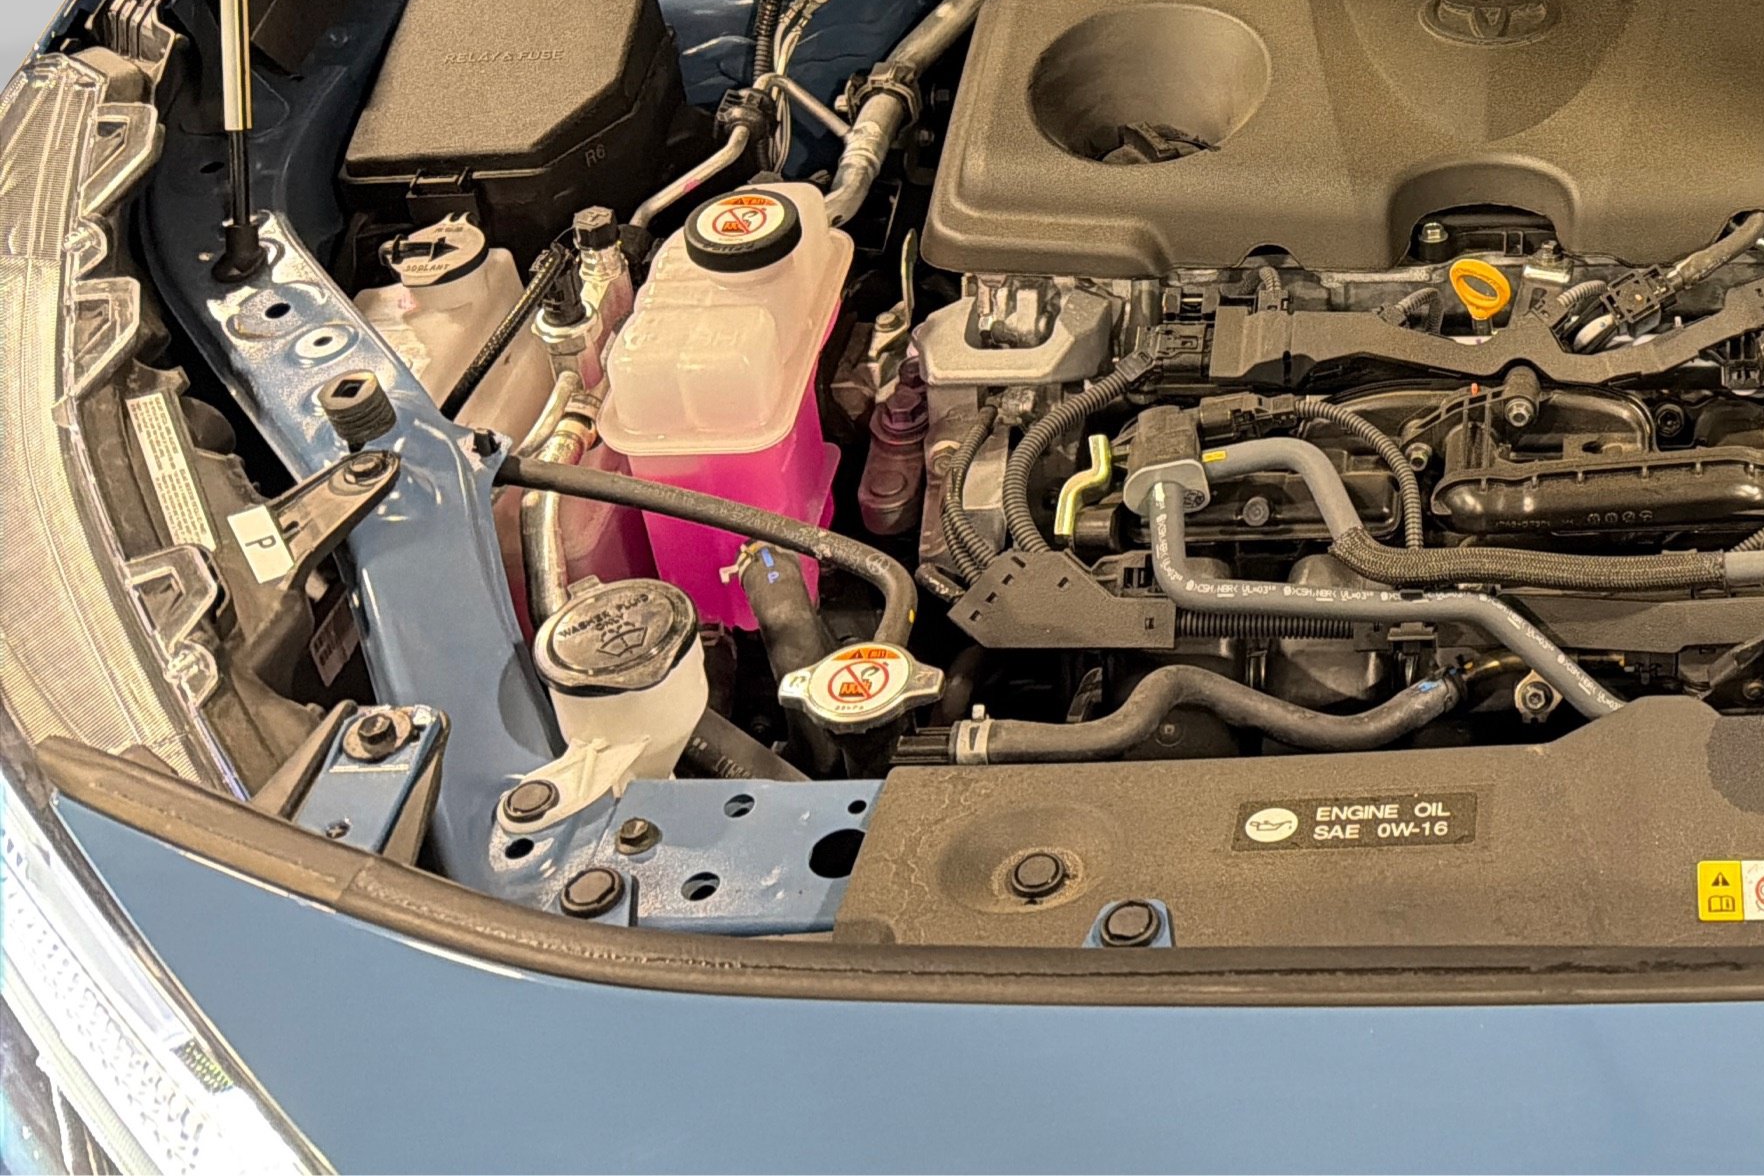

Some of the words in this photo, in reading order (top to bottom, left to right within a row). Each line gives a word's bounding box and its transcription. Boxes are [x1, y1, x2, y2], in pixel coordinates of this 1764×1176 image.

[444, 52, 500, 65] RELAY
[502, 52, 514, 63] &
[517, 49, 565, 62] FUSE
[585, 144, 606, 168] R6
[244, 534, 277, 549] P
[557, 610, 612, 638] WASHER
[616, 593, 649, 612] FLUID
[596, 612, 624, 630] ONLY
[1315, 804, 1399, 822] ENGINE
[1414, 802, 1451, 818] OIL
[1313, 824, 1361, 841] SAE
[1377, 821, 1449, 838] 0W-16
